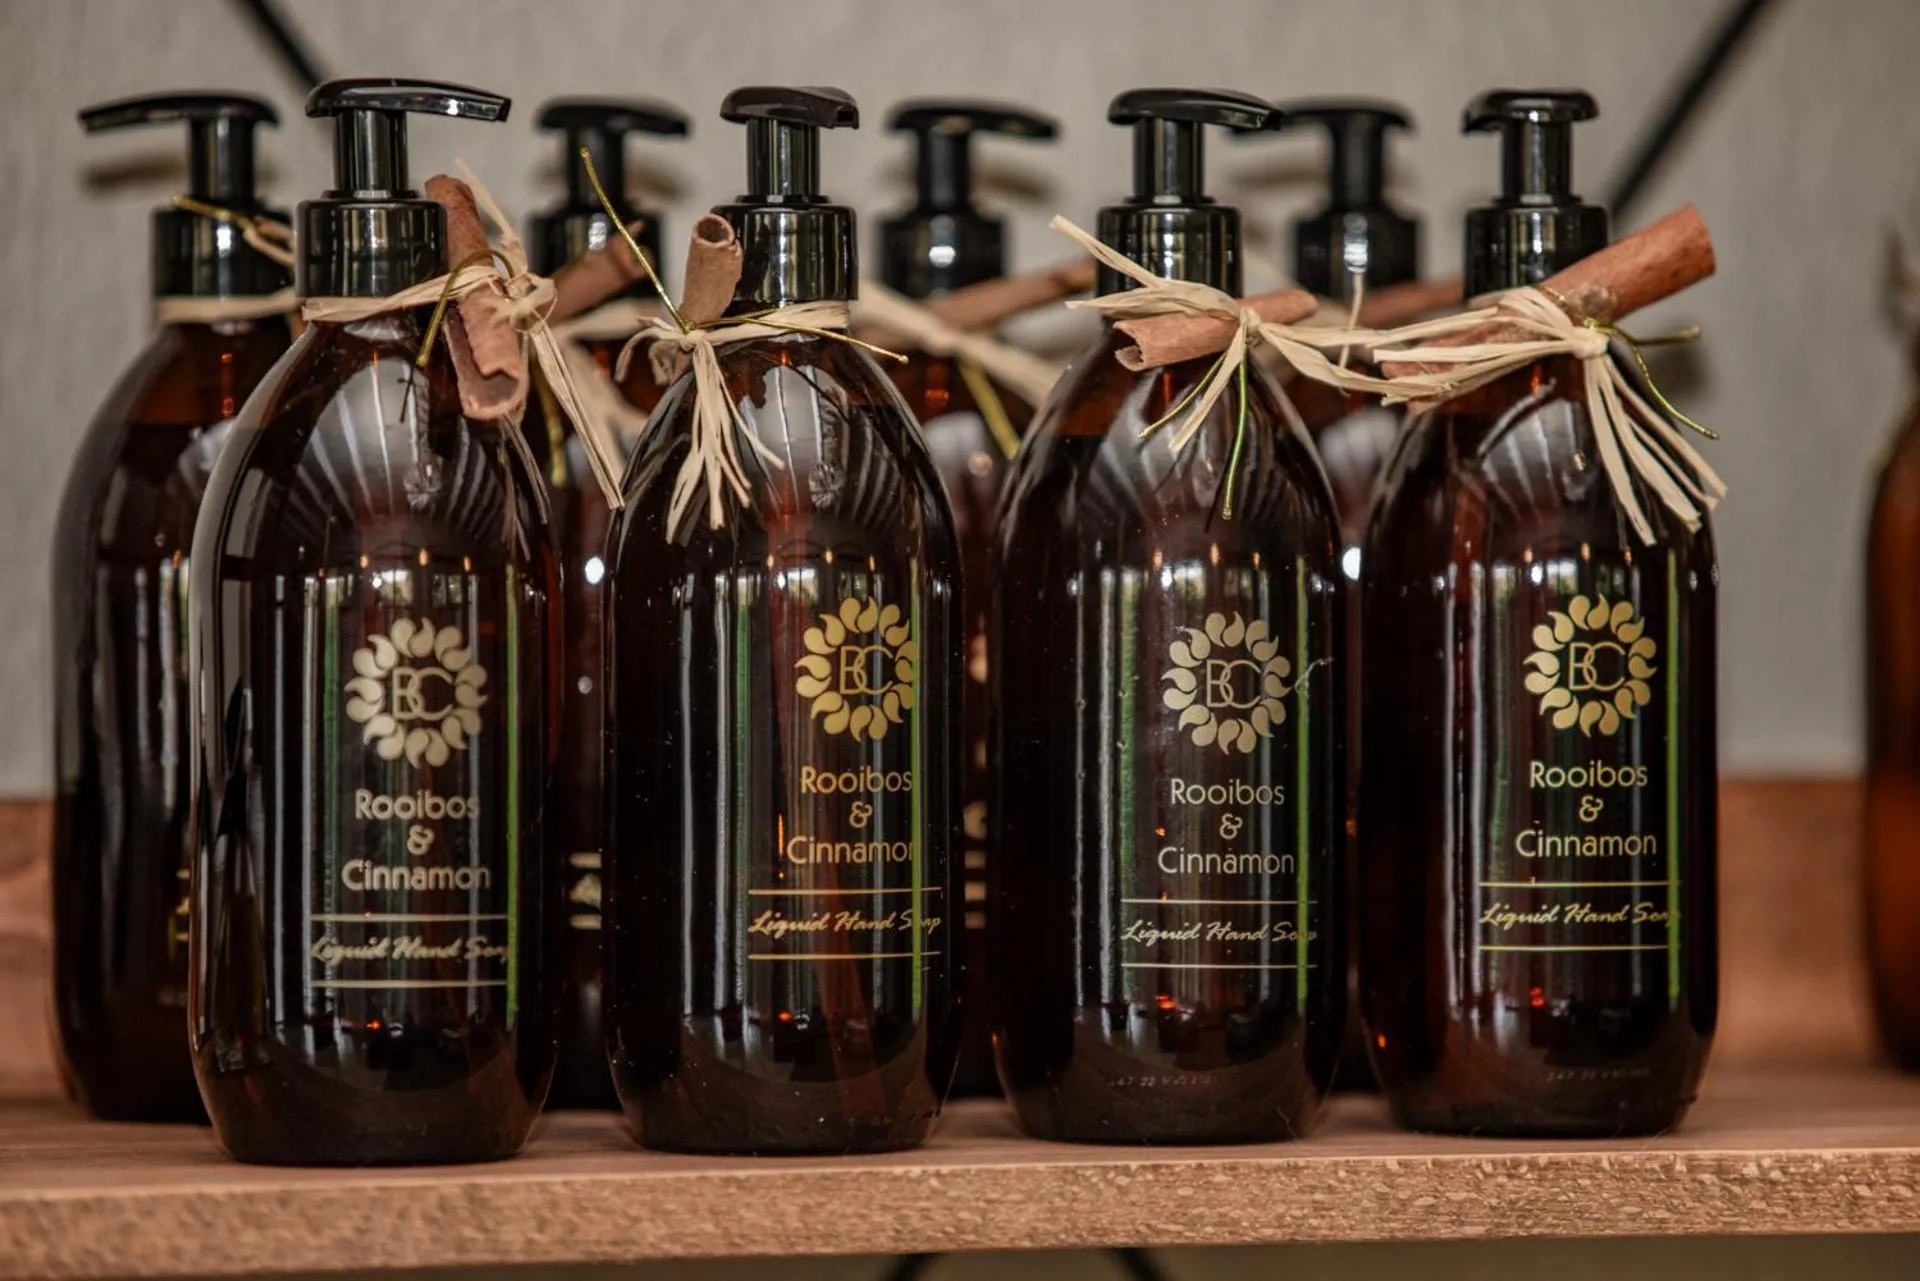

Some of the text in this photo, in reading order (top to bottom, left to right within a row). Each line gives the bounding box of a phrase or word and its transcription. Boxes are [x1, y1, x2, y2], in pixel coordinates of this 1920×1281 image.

[840, 645, 894, 695] BC
[1569, 641, 1626, 692] BC
[392, 666, 454, 721] BC
[1206, 659, 1263, 710] BC
[801, 766, 912, 794] Rooibos
[1530, 760, 1648, 788] Rooibos
[355, 788, 480, 820] Rooibos
[1171, 777, 1285, 806] Rooibos
[849, 801, 873, 828] &
[1579, 795, 1604, 822] &
[407, 824, 435, 856] &
[1219, 813, 1243, 840] &
[1515, 830, 1657, 858] Cinnamon
[341, 859, 491, 891] Cinnamon
[1158, 847, 1295, 875] Cinnamon
[748, 911, 829, 939] Liquid
[833, 911, 896, 932] Hand
[1481, 903, 1559, 930] Liquid
[1563, 904, 1630, 925] Hand
[1121, 919, 1202, 947] Liquid
[1206, 921, 1269, 941] Hand
[311, 936, 390, 967] Liquid
[393, 936, 462, 960] Hand
